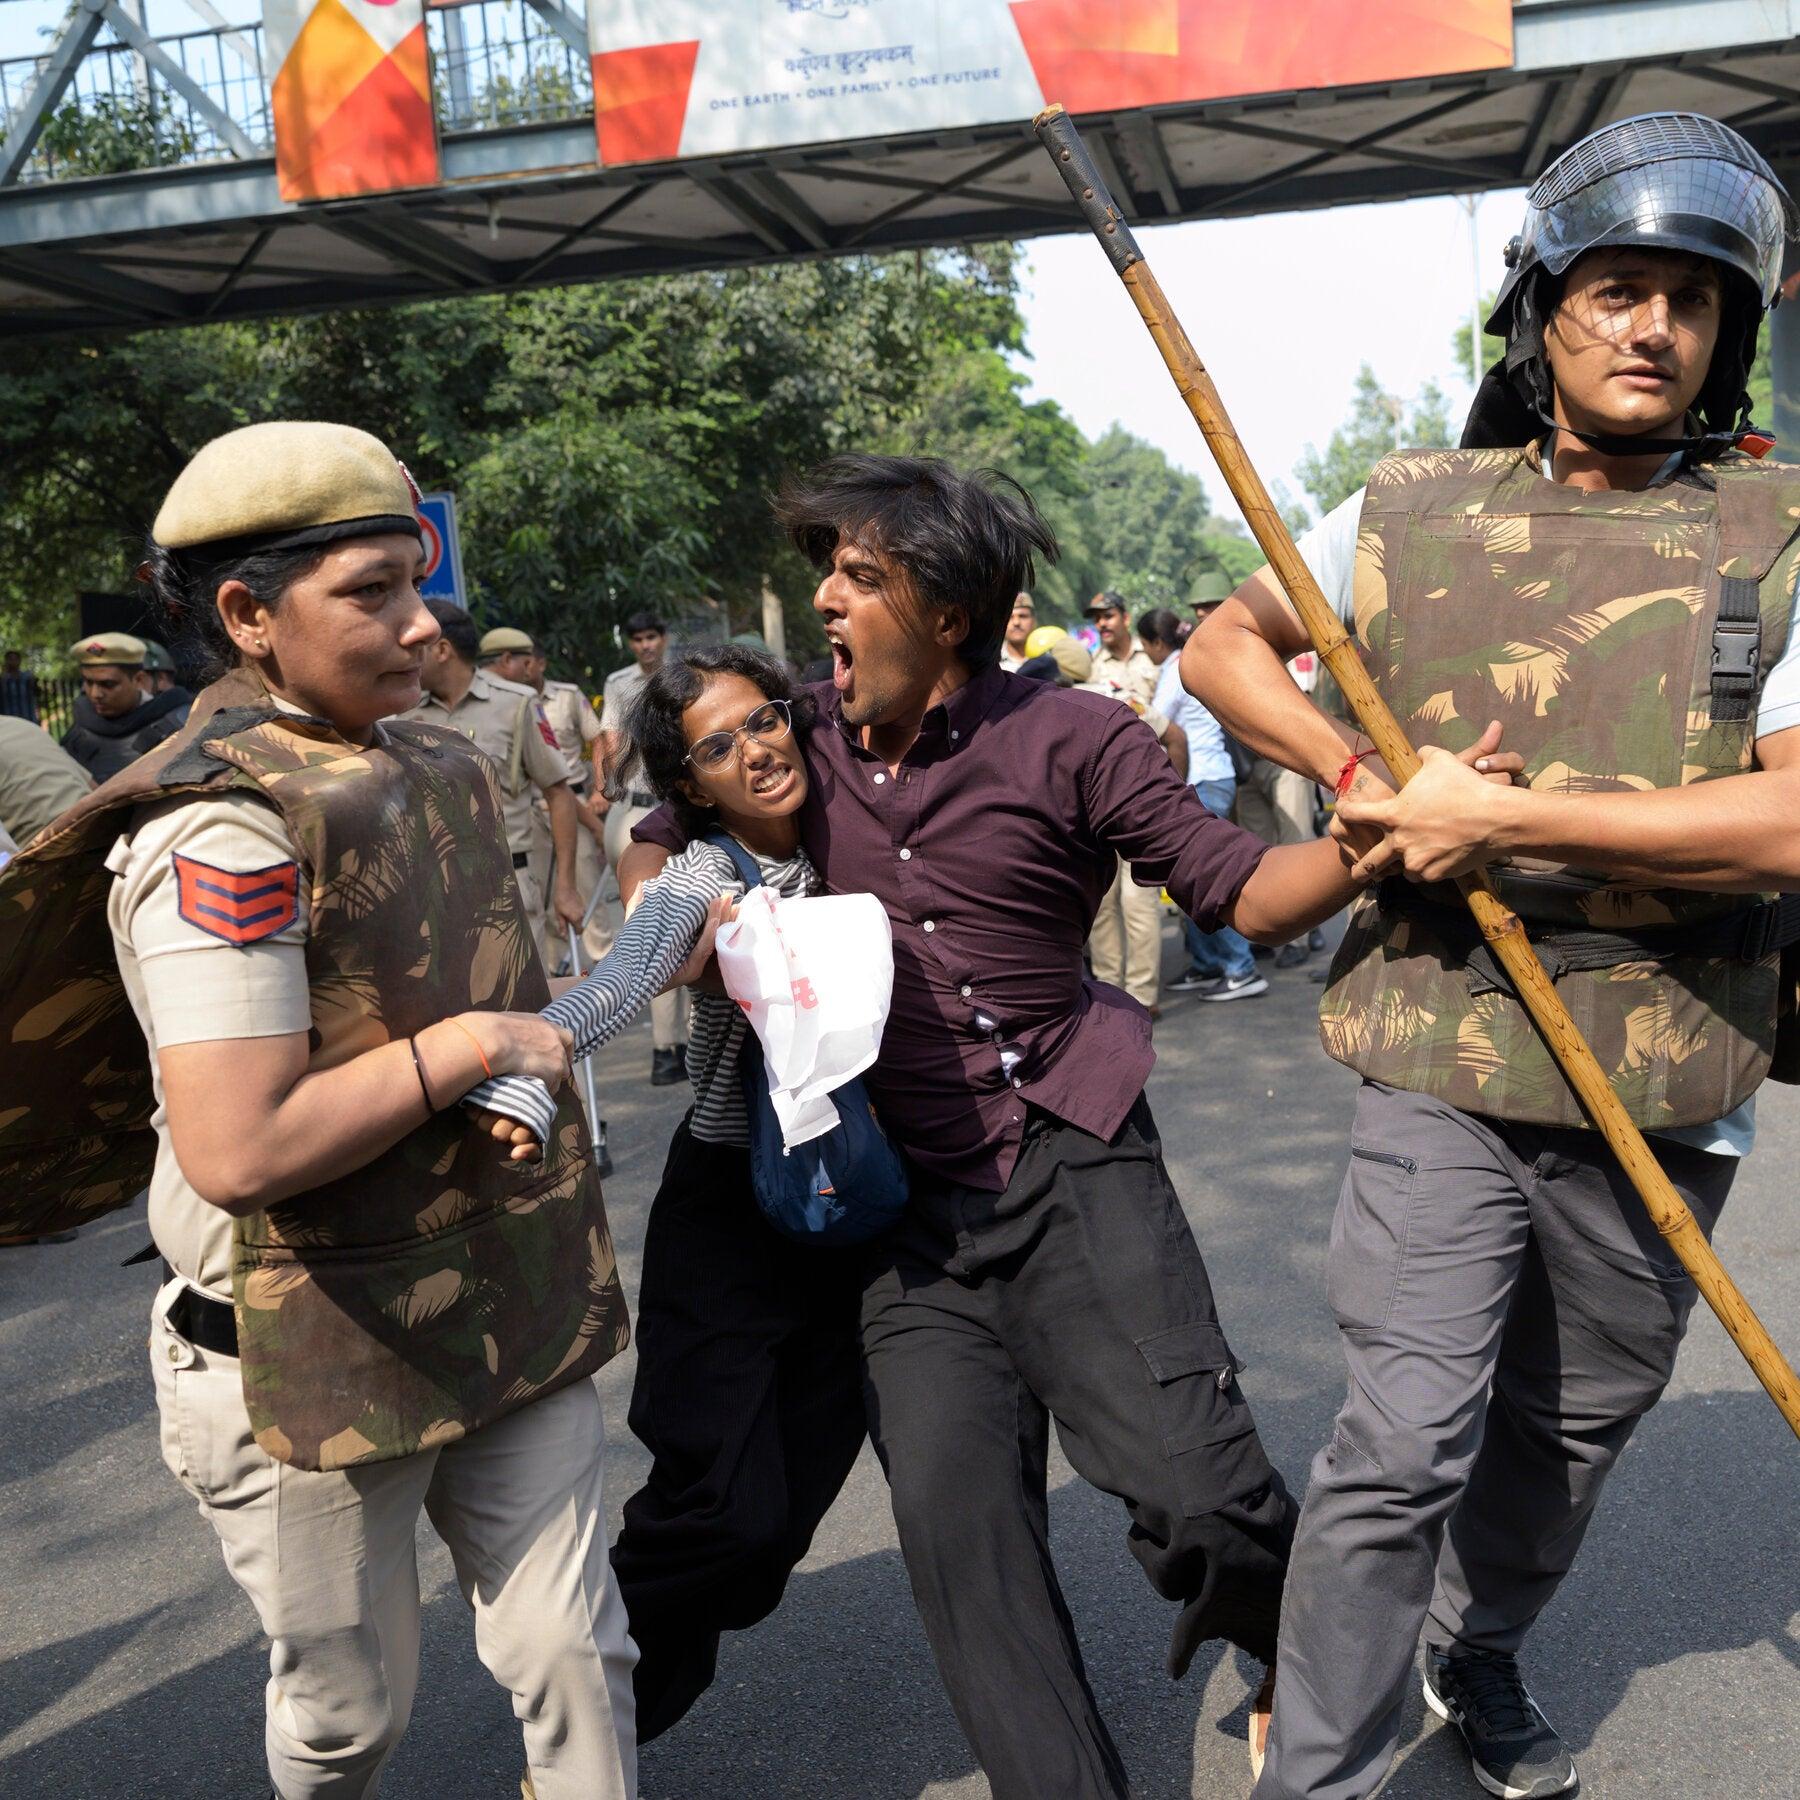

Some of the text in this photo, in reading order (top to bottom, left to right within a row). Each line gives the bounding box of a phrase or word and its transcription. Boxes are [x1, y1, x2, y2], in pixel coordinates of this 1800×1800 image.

[709, 67, 1000, 110] ONE EARTH ONE FAMILY ONE FUTURE
